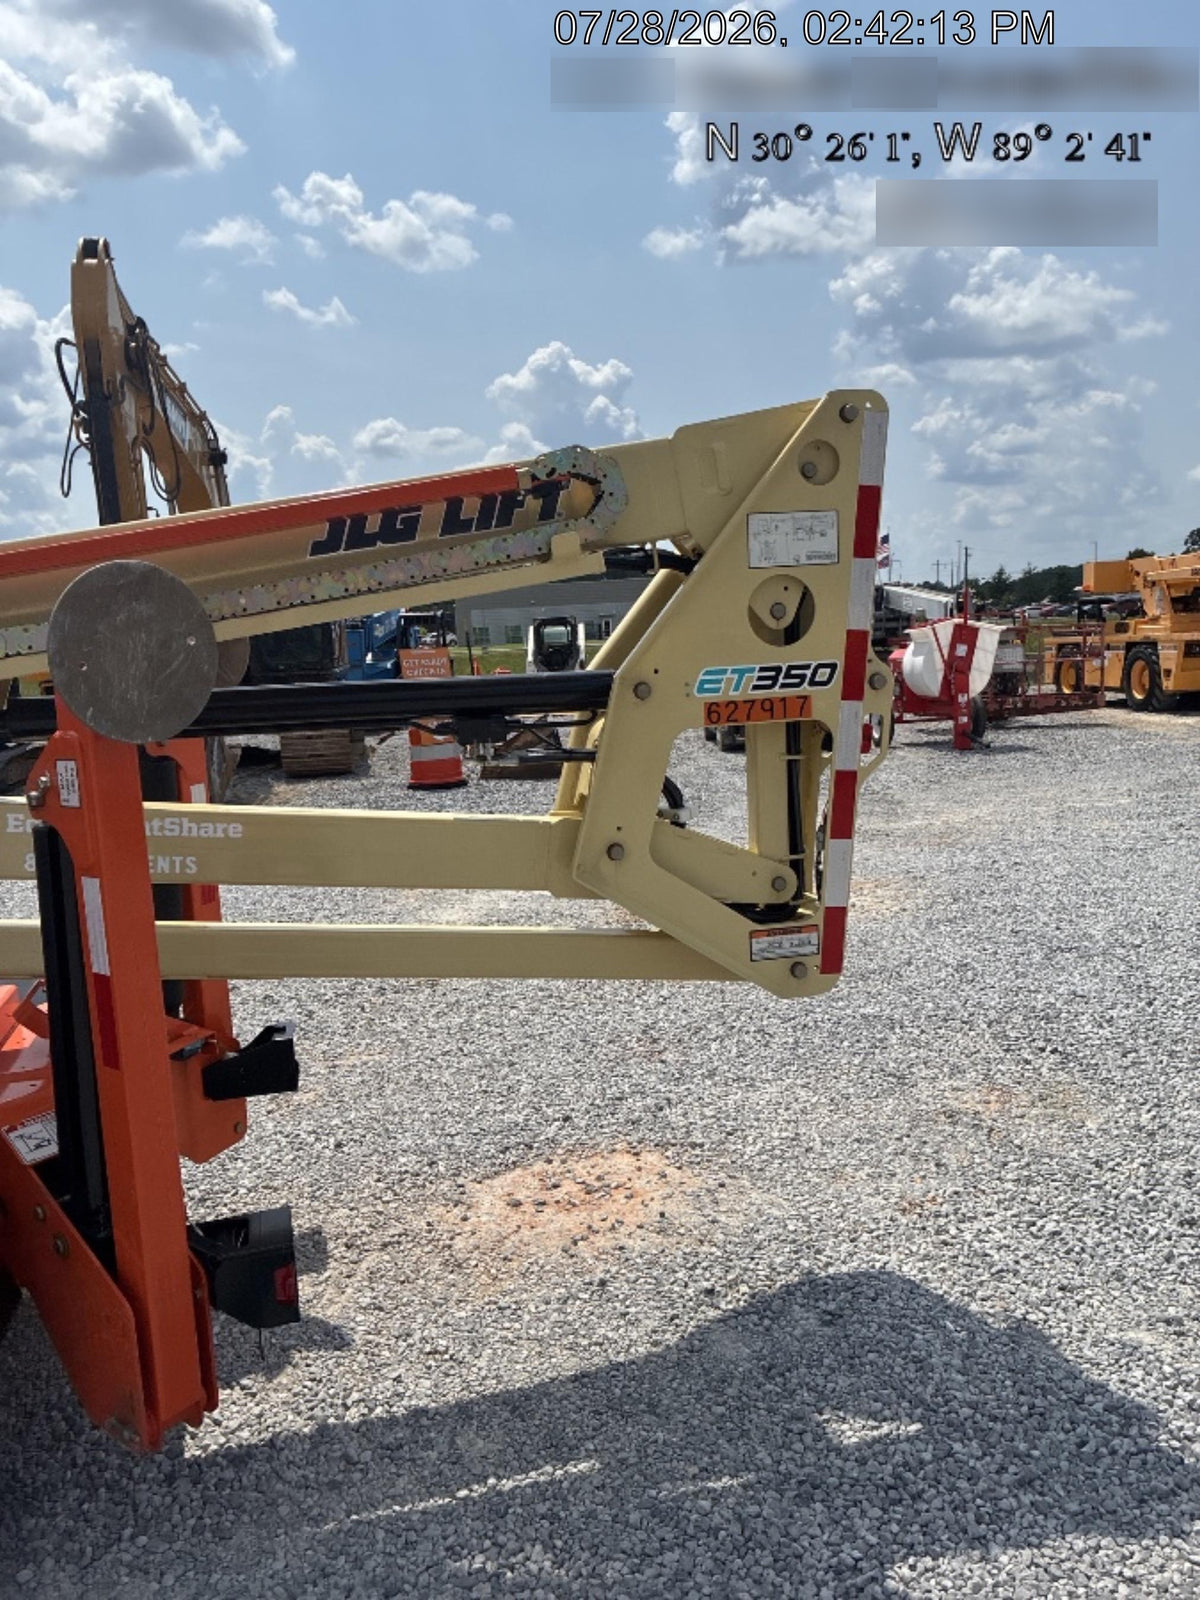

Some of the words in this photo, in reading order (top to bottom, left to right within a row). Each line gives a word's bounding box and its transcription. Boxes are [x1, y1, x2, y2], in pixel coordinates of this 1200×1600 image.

[308, 504, 423, 557] JLG
[438, 479, 571, 538] LIFT
[694, 660, 839, 697] ET350
[706, 695, 808, 724] 627917
[6, 813, 243, 838] EtShare
